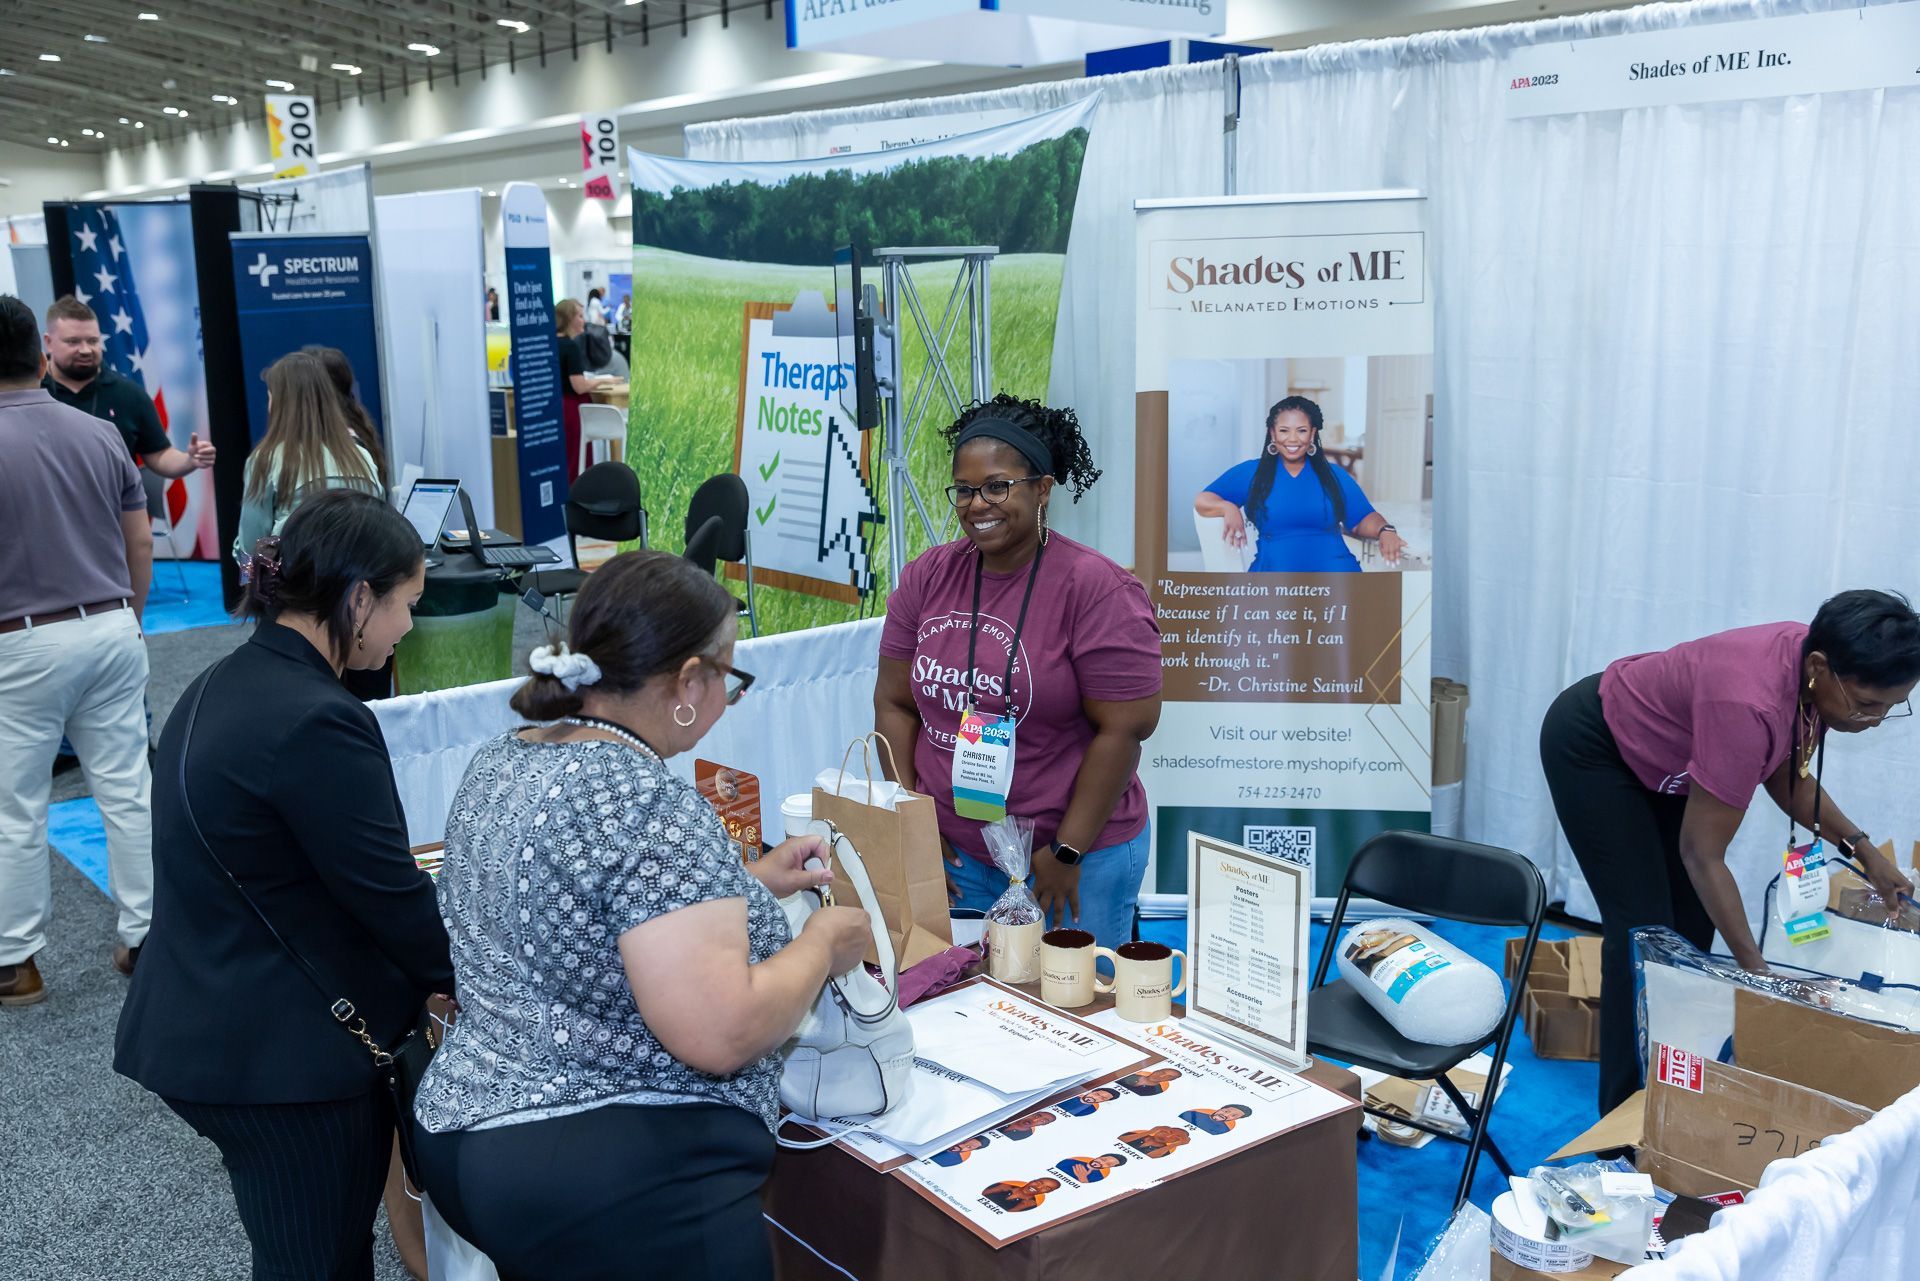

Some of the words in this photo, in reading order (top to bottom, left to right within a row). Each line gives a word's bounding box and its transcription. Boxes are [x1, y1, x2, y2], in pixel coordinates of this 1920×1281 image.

[1629, 60, 1686, 81] Shades
[1692, 56, 1710, 75] of
[1714, 52, 1749, 72] ME
[1756, 50, 1791, 68] Inc.
[1510, 74, 1559, 90] APA2023
[289, 102, 313, 158] 200
[598, 119, 615, 166] 100
[284, 256, 359, 274] SPECTRUM
[1167, 255, 1305, 293] Shades
[1317, 262, 1342, 282] of
[1348, 250, 1405, 281] ME
[1190, 300, 1287, 313] MELANATED
[1293, 297, 1380, 311] EMOTIONS
[758, 396, 822, 436] Notes
[1158, 579, 1269, 599] "Representation
[1275, 582, 1330, 597] matters
[1157, 603, 1210, 620] because
[1216, 605, 1228, 622] if
[1233, 605, 1239, 620] I
[1244, 609, 1270, 620] can
[1275, 609, 1297, 620] see
[1303, 606, 1317, 622] it,
[1323, 605, 1336, 623] if
[1341, 605, 1348, 620] I
[1186, 628, 1241, 647] identify
[1247, 630, 1261, 646] it,
[1268, 629, 1302, 644] then
[1306, 630, 1313, 644] I
[1317, 634, 1344, 645] can
[1194, 652, 1250, 670] through
[1256, 653, 1279, 668] it."
[912, 655, 1003, 697] Shades
[1238, 676, 1307, 693] Christine
[1313, 678, 1363, 693] Sainvil
[922, 683, 939, 698] of
[961, 723, 1010, 739] APA2023
[1210, 726, 1244, 741] Visit
[1250, 730, 1277, 741] our
[1282, 728, 1352, 742] website!
[962, 750, 996, 763] CHRISTINE
[1152, 755, 1402, 774] shadesofmestore.myshopify.com
[1786, 852, 1823, 870] APA2023
[1220, 862, 1250, 880] Shades
[1236, 885, 1259, 899] Posters
[1136, 987, 1160, 995] Shades
[1226, 987, 1263, 1006] Accessories
[989, 1000, 1052, 1031] Shades
[1052, 1028, 1064, 1037] of
[1065, 1032, 1100, 1050] ME
[1145, 1024, 1229, 1065] Shades
[1228, 1063, 1250, 1078] of
[1249, 1070, 1290, 1092] ME
[1113, 1141, 1144, 1161] Fristre
[1047, 1166, 1081, 1190] Lanmou
[976, 1196, 1004, 1216] Eksite
[1522, 1239, 1539, 1249] TICKET
